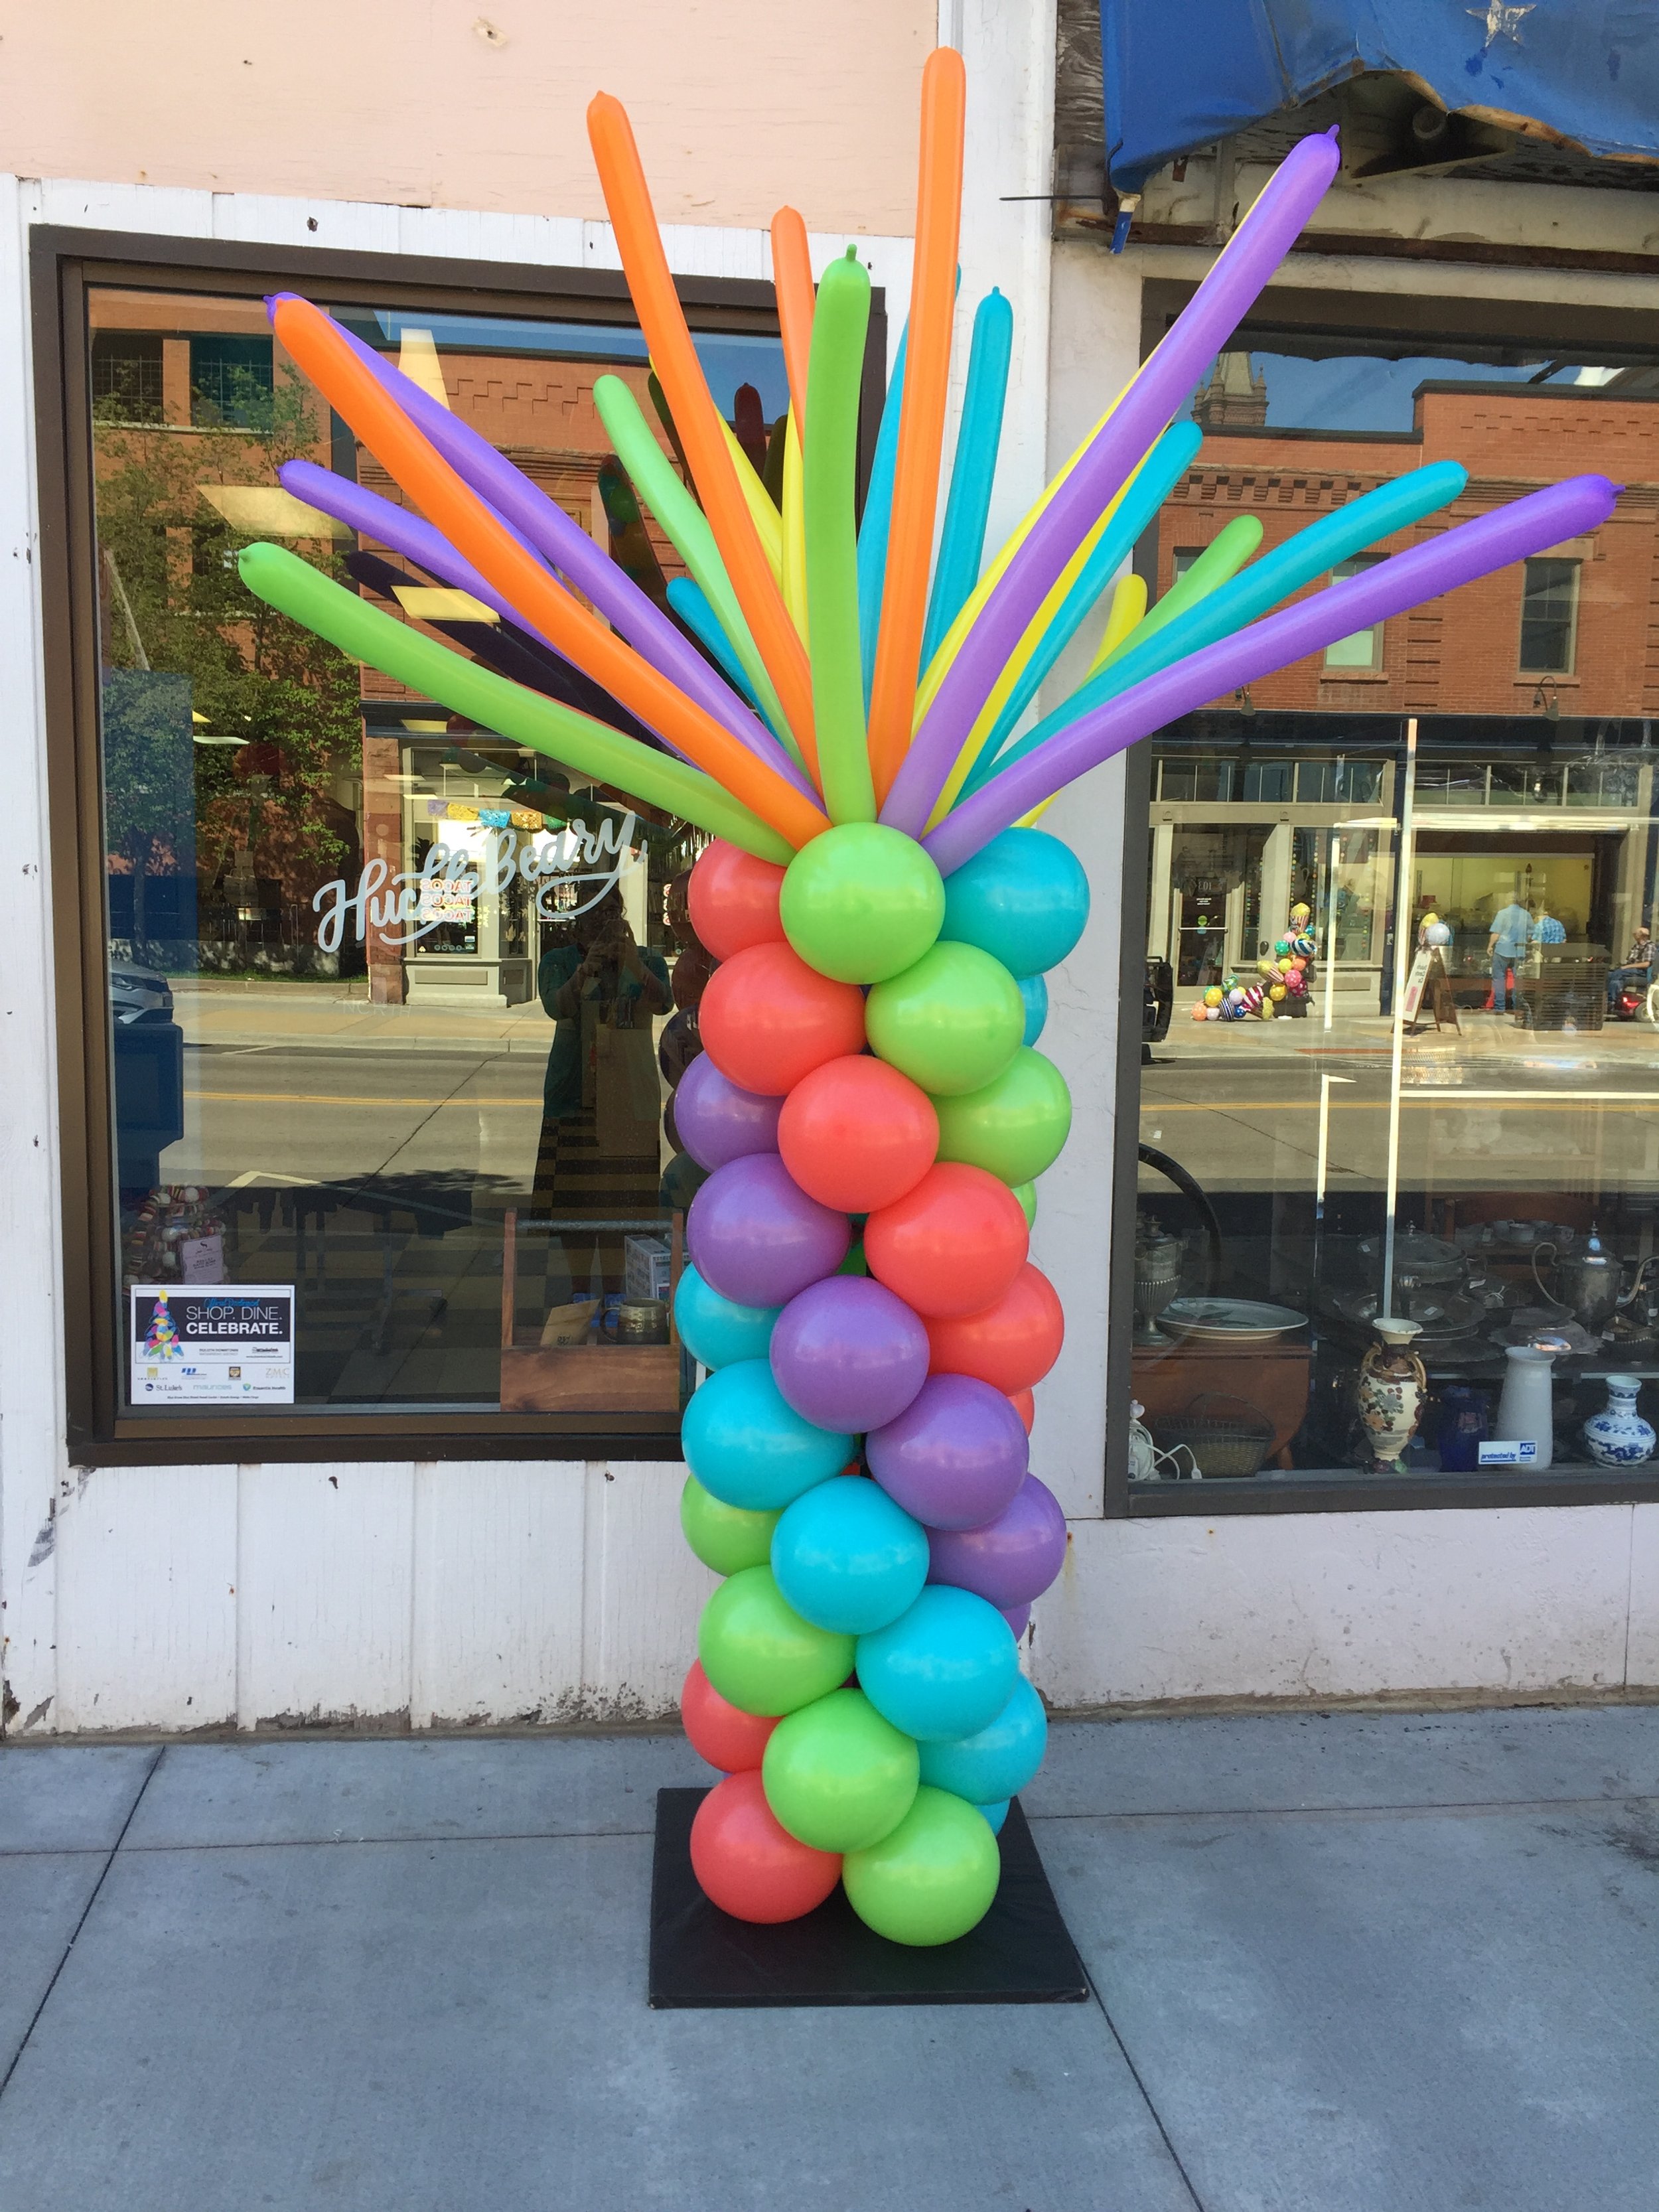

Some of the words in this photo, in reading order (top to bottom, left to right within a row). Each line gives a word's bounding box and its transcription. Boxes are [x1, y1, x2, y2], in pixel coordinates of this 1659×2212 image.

[186, 1306, 235, 1320] SHOP.
[242, 1306, 283, 1320] DINE.
[186, 1322, 283, 1334] CELEBRATE.
[1520, 1444, 1536, 1453] ADT
